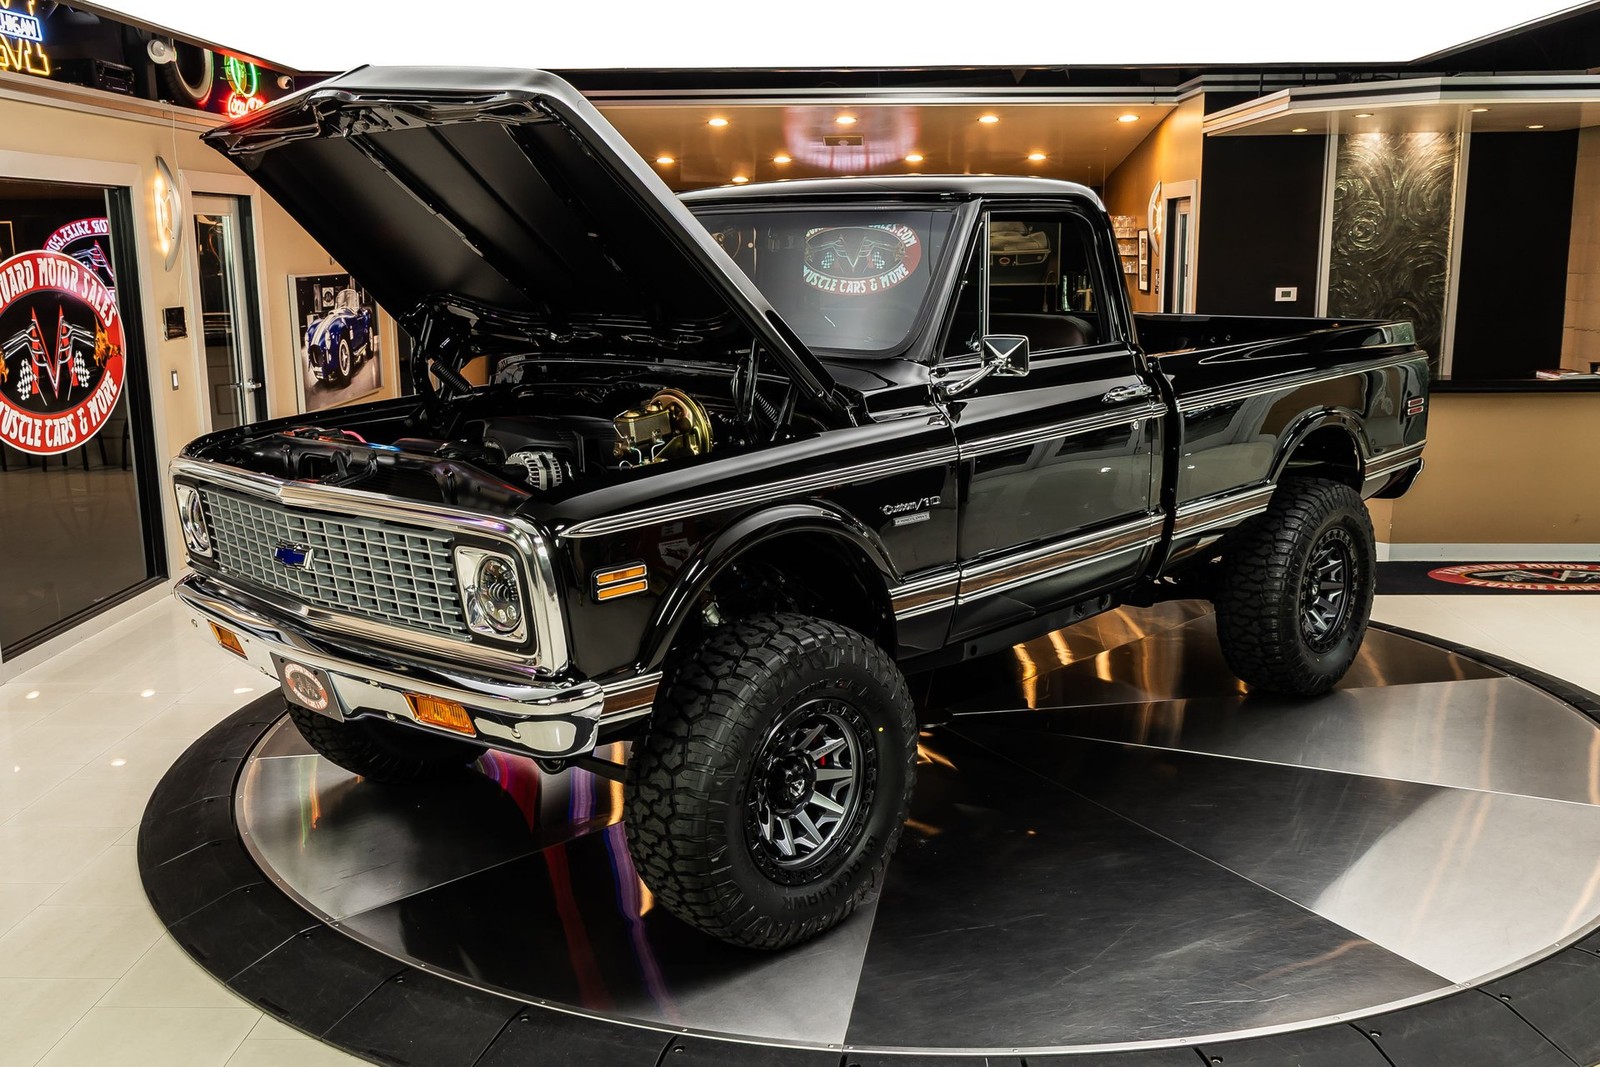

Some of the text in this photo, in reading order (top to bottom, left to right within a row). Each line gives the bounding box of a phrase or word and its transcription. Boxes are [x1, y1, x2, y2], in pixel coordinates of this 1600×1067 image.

[0, 12, 37, 38] HIGAN
[0, 256, 118, 328] UARD MOTOR SALES
[839, 280, 867, 294] CARS
[869, 278, 879, 292] &
[879, 263, 910, 289] MORE
[0, 369, 118, 448] USCLE CARS & MORE
